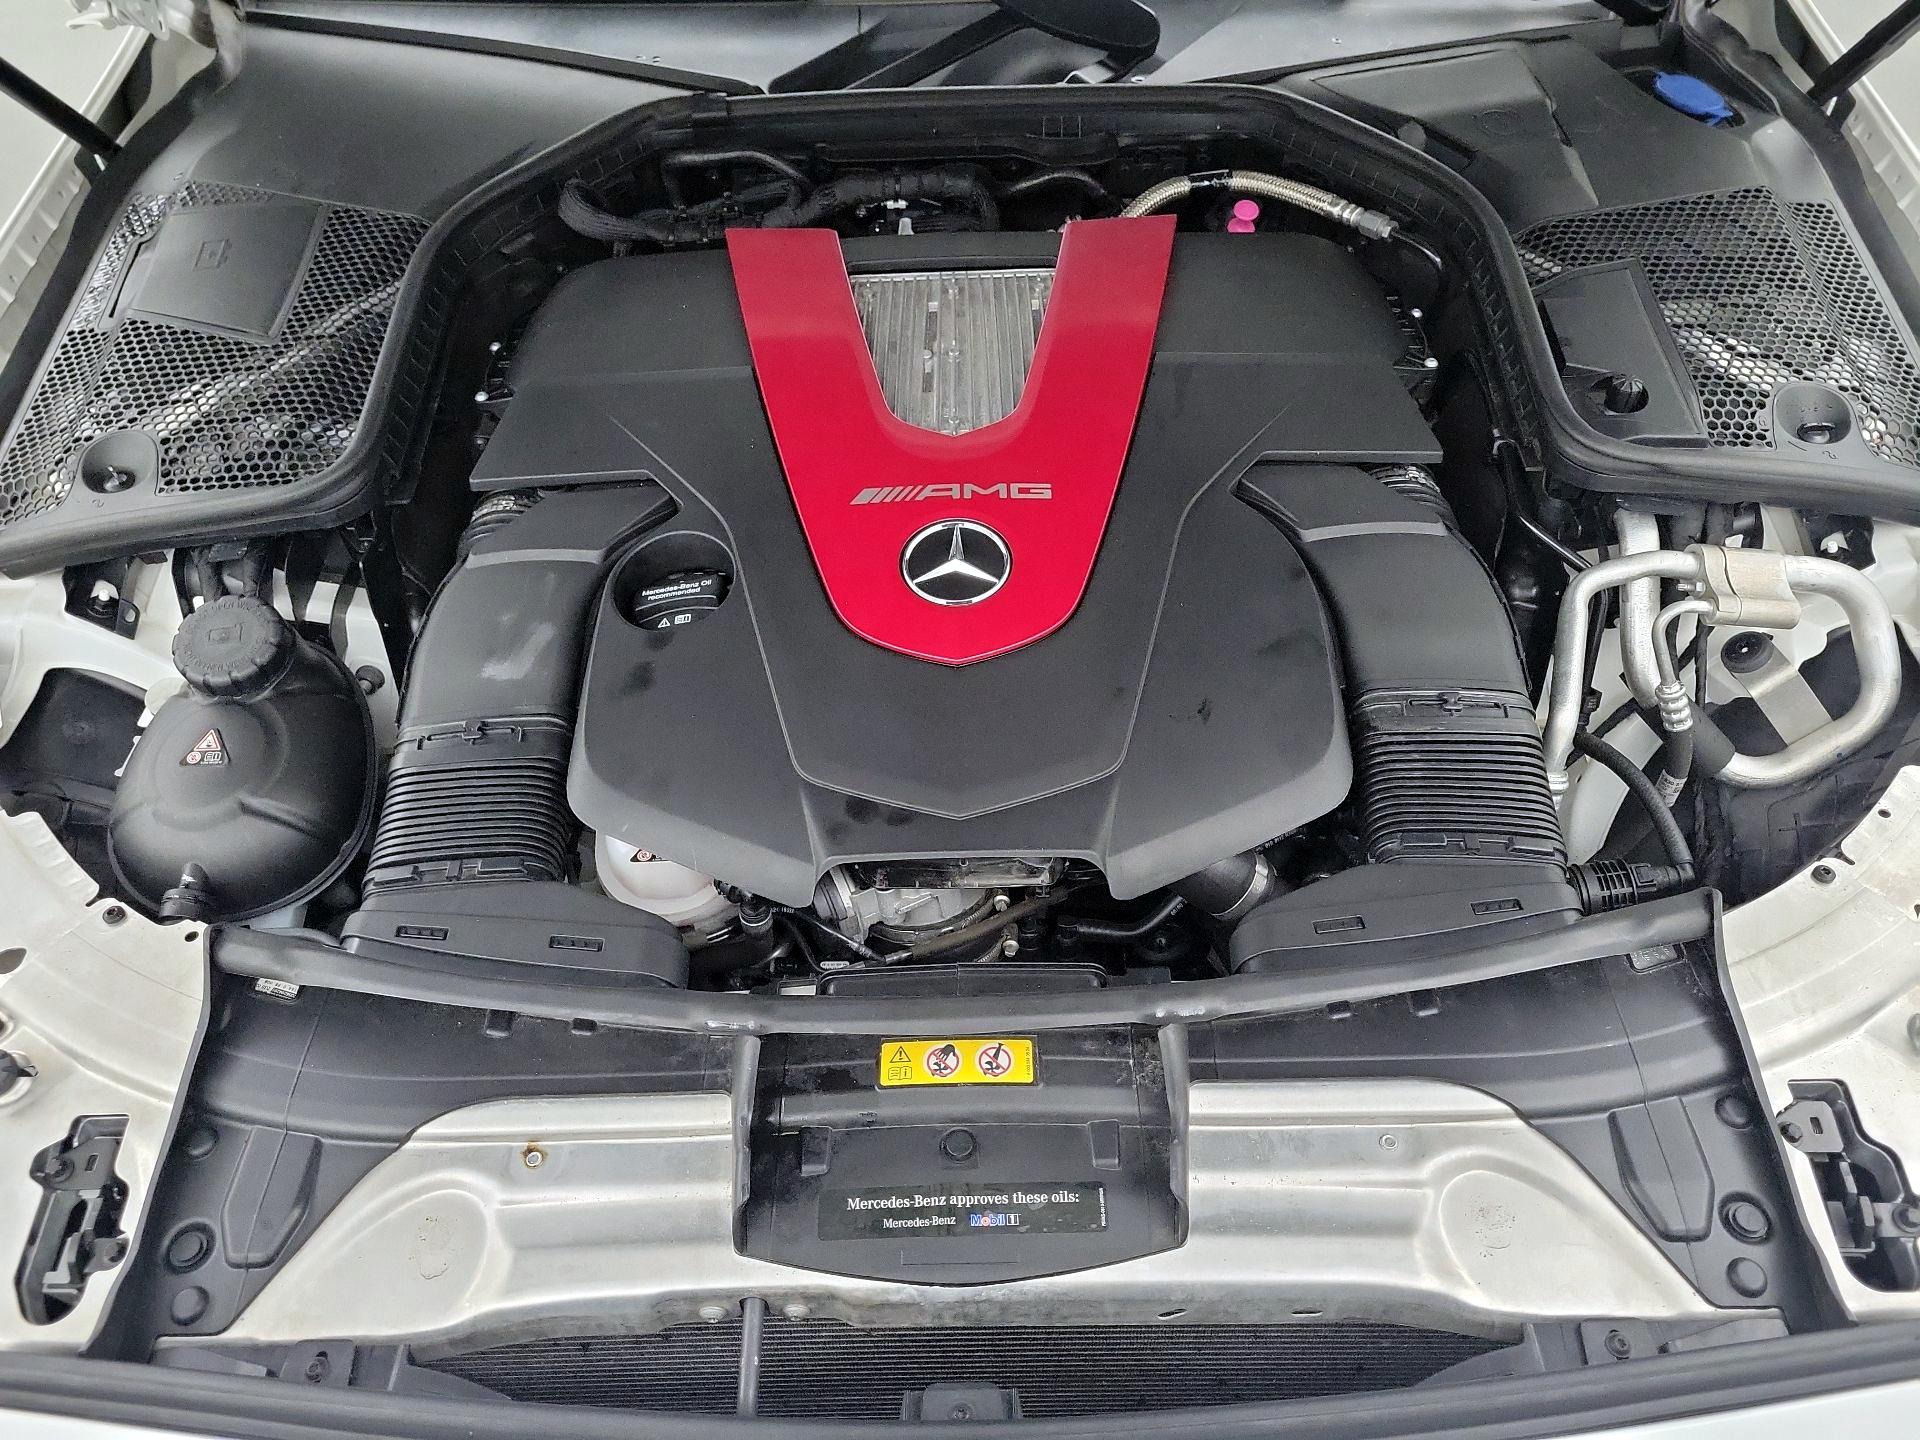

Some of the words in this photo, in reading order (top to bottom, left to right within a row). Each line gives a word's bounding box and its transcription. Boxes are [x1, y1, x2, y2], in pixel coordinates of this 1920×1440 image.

[915, 483, 1052, 501] AMG
[642, 582, 699, 597] Mercedes-Benz
[647, 587, 701, 600] recommended
[846, 1194, 947, 1211] Mercedes-Benz
[950, 1194, 1009, 1208] approves
[1012, 1191, 1048, 1204] these
[1051, 1190, 1080, 1203] oils:
[882, 1215, 956, 1229] Mercedes-Benz
[970, 1213, 1006, 1226] Mobil
